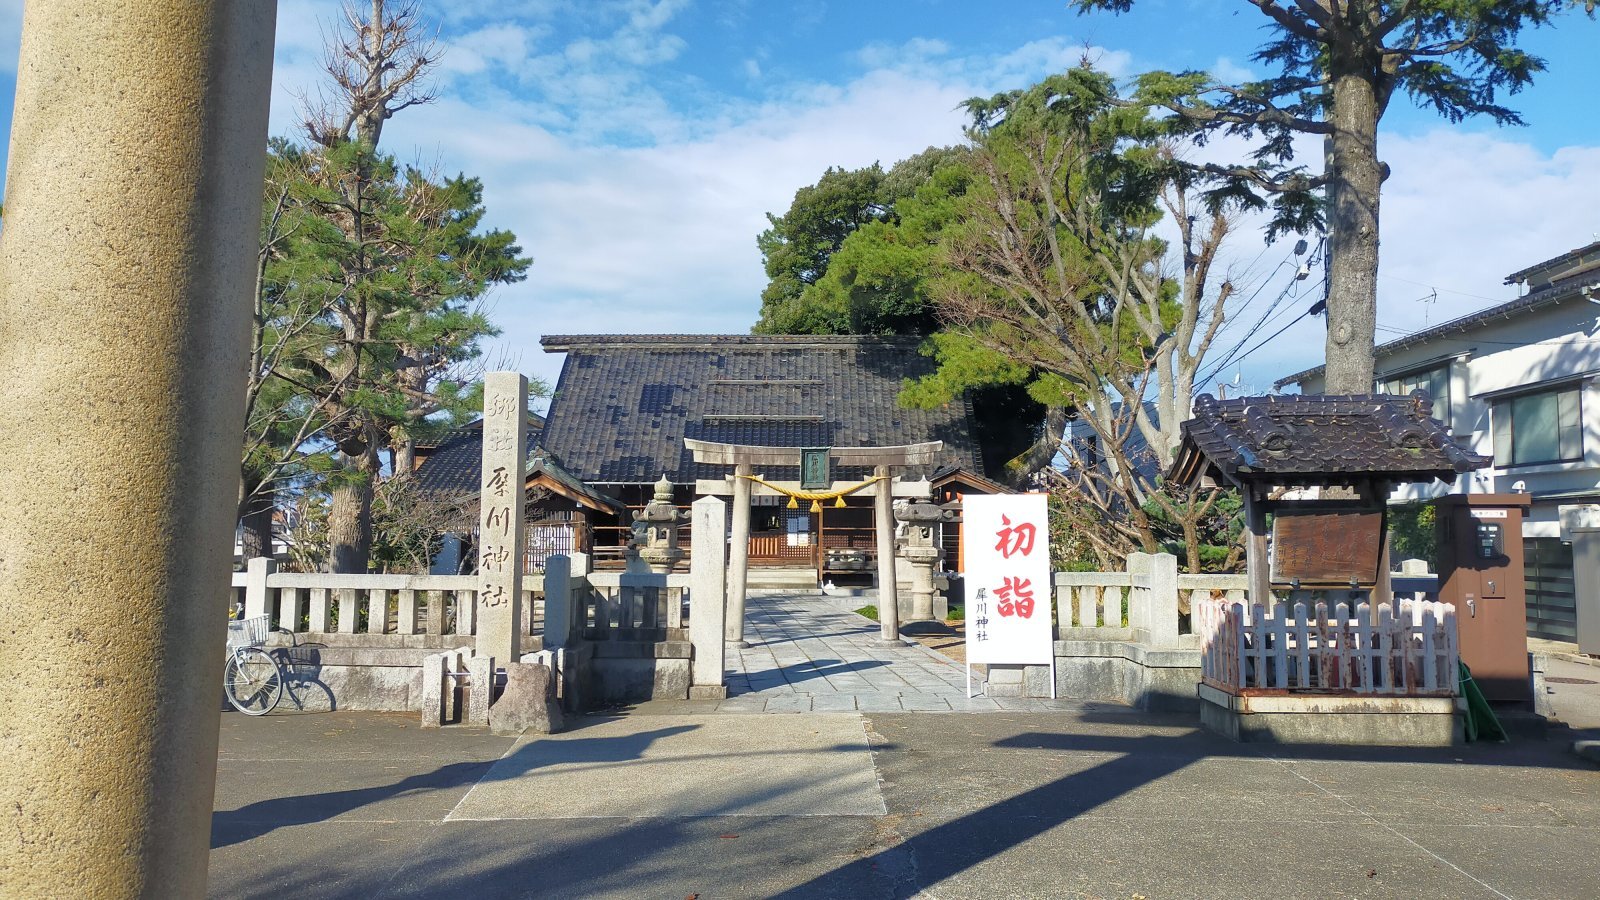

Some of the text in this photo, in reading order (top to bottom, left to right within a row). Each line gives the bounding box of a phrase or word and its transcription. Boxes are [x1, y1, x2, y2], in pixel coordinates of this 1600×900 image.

[993, 513, 1037, 620] 初詣
[975, 587, 989, 642] 犀川神社
